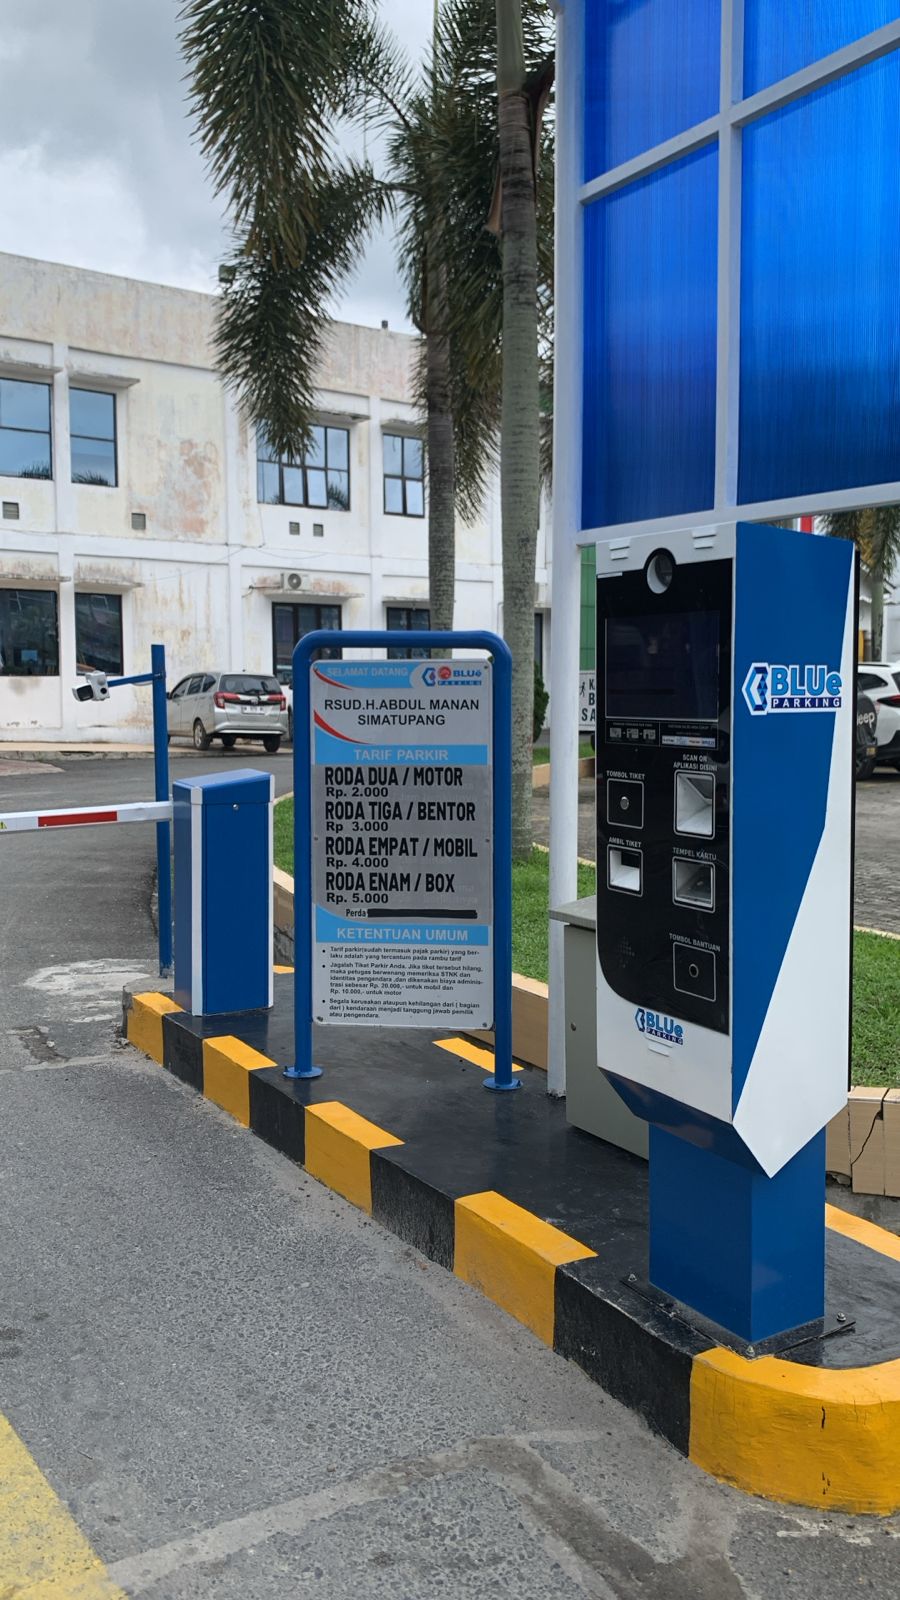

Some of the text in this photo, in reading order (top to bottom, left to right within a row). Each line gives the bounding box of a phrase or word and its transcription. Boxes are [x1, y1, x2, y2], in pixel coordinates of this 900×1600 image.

[328, 667, 408, 677] SELAMAT DATANG
[771, 667, 842, 696] BLUe
[325, 699, 479, 710] RSUD.H.ABDUL MANAN
[772, 698, 841, 708] PARKING
[358, 715, 446, 725] SIMATUPANG
[353, 749, 448, 760] TARIF PARKIR
[682, 754, 698, 762] SCAN
[673, 762, 698, 770] APLIKASI
[325, 767, 463, 786] RODA DUA / MOTOR
[606, 770, 646, 780] TOMBOL TIKET
[326, 787, 389, 799] Rp. 2.000
[325, 801, 476, 821] RODA TIGA / BENTOR
[326, 821, 389, 834] Rp 3.000
[325, 837, 478, 857] RODA EMPAT / MOBIL
[608, 836, 642, 848] AMBIL TIKET
[672, 847, 717, 861] TEMPEL KARTU
[326, 857, 389, 870] Rp. 4.000
[325, 872, 455, 893] RODA ENAM / BOX
[326, 893, 389, 905] Rp. 5.000
[346, 908, 367, 918] Perda
[337, 927, 469, 941] KETENTUAN UMUM
[669, 932, 721, 952] TOMBOL BANTUAN
[402, 1007, 432, 1015] tanggung
[646, 1011, 683, 1038] BLUe
[646, 1027, 683, 1045] PARKING
